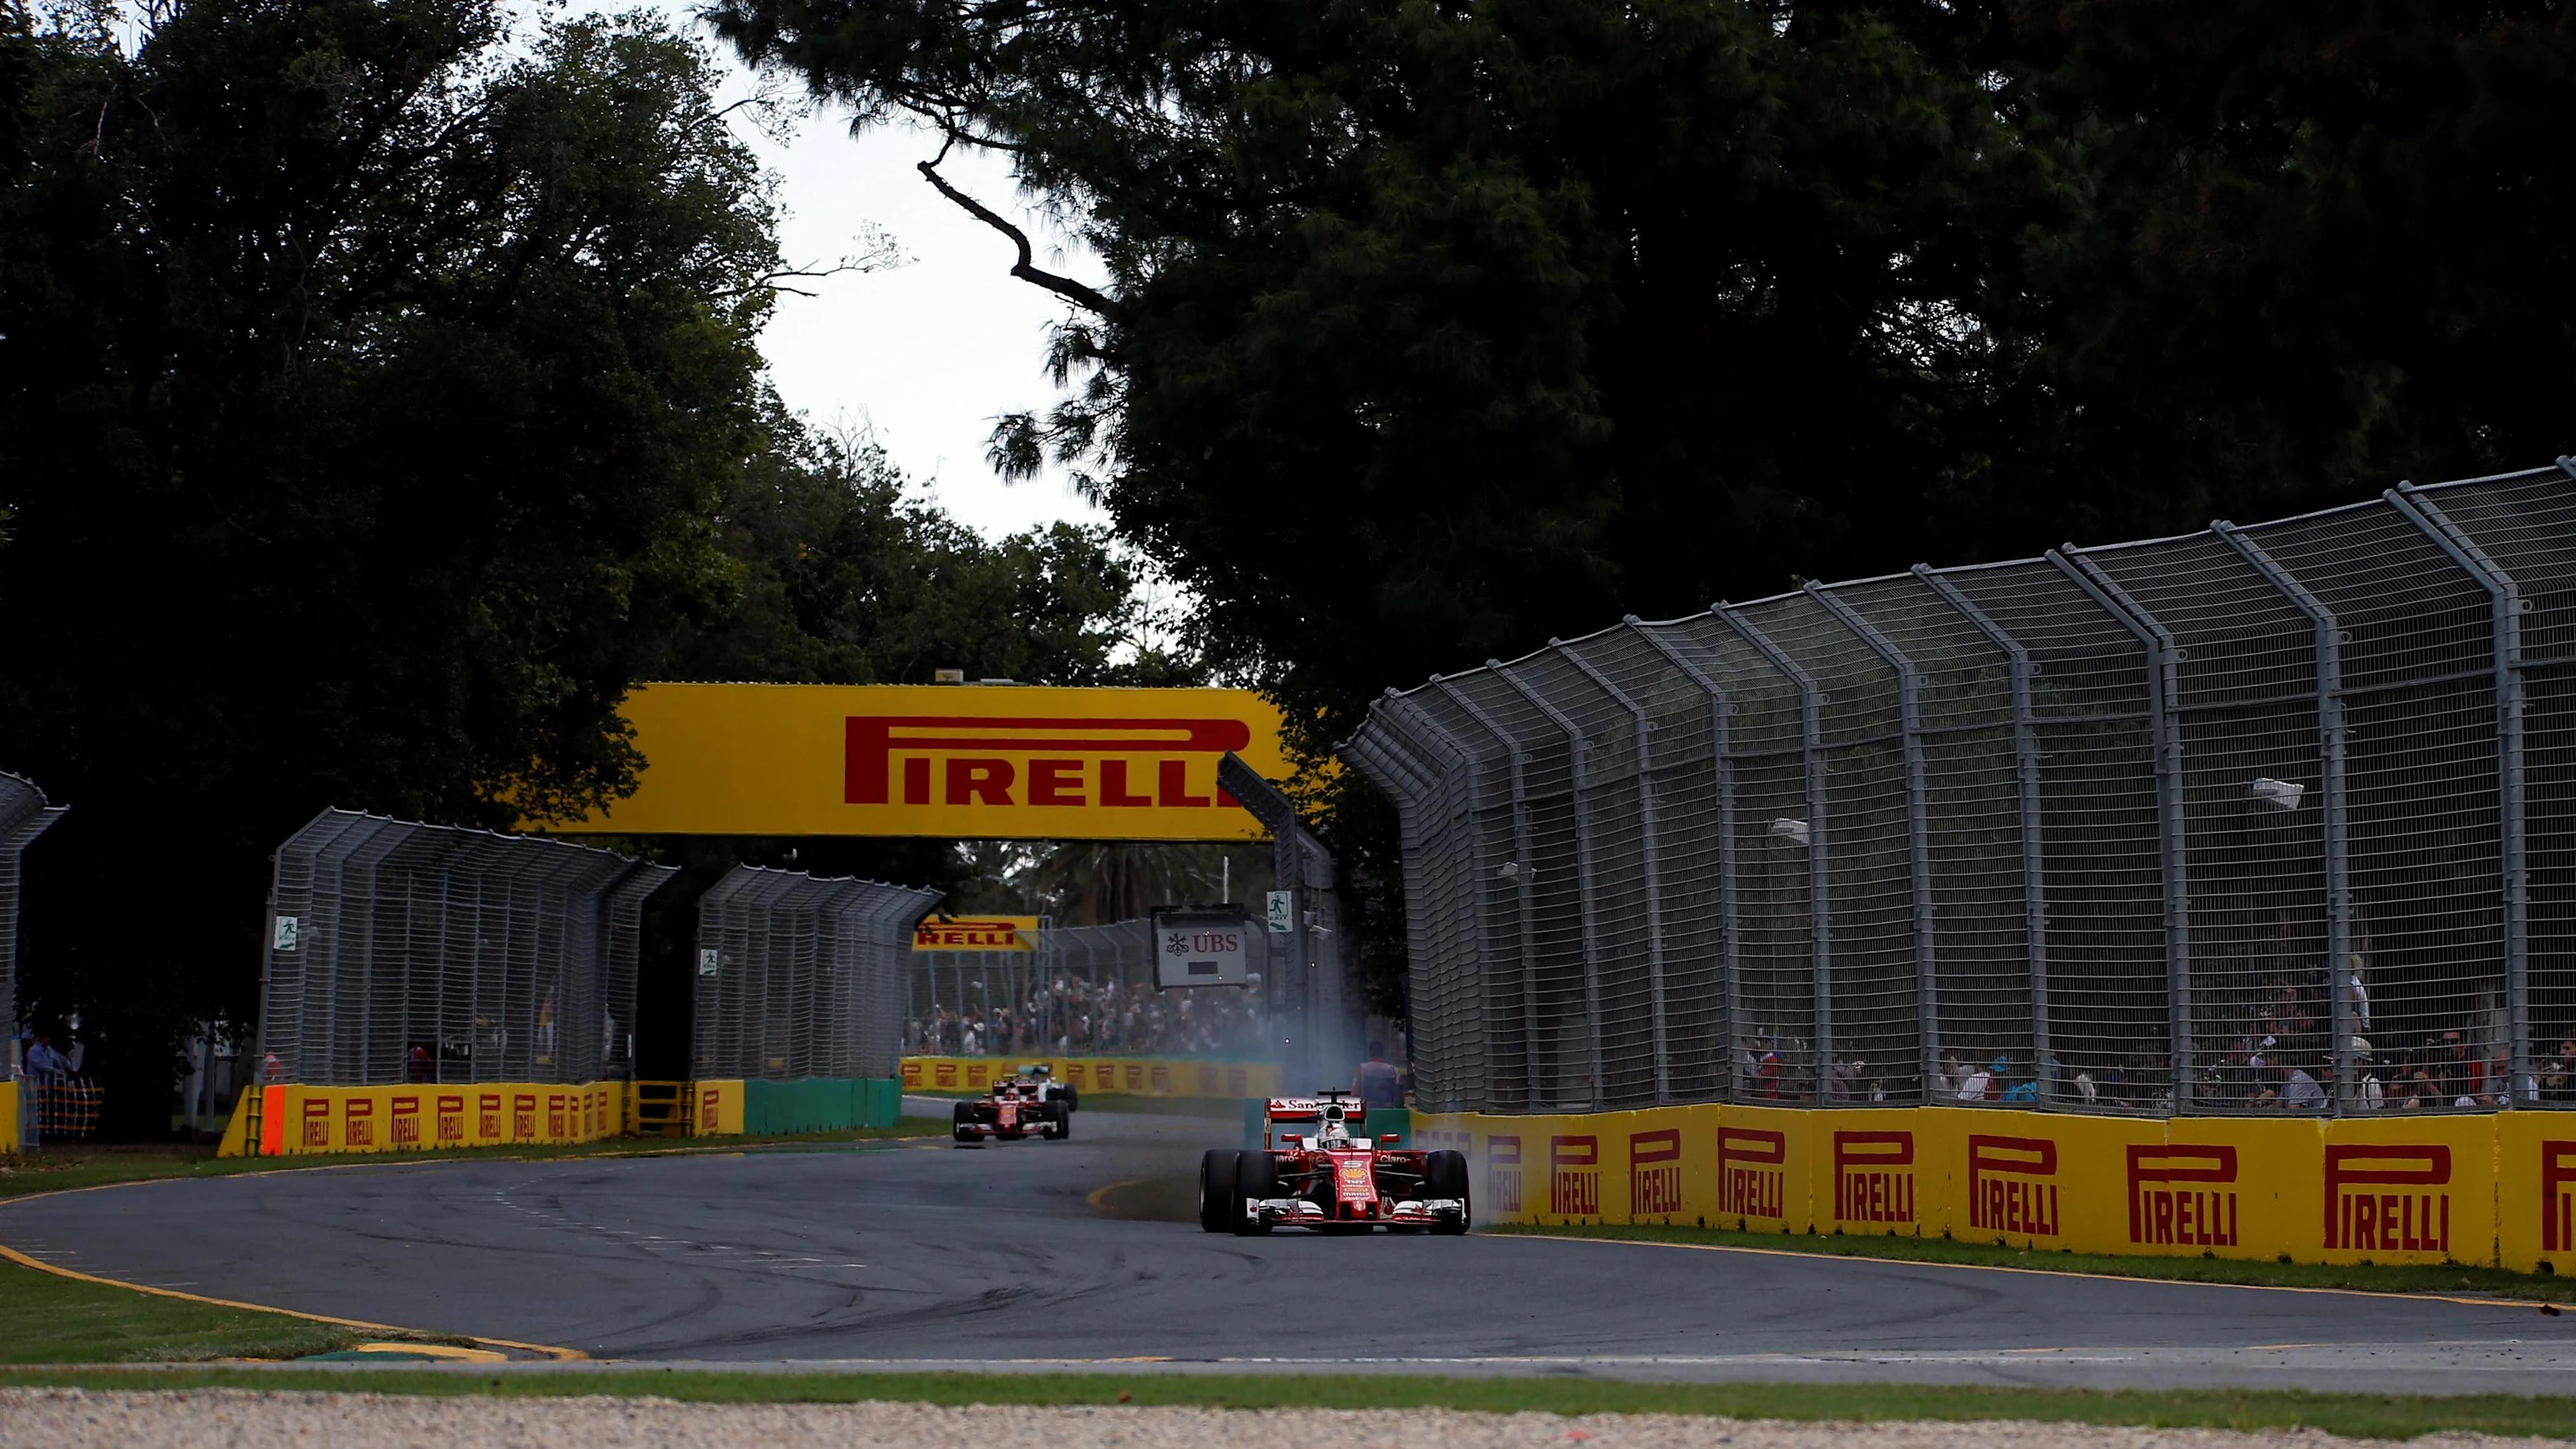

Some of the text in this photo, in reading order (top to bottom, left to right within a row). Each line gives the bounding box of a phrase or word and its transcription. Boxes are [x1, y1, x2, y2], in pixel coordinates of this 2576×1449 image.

[845, 716, 1250, 808] PIRELL
[1192, 934, 1238, 952] UBS
[1275, 1154, 1295, 1162] laro
[1380, 1154, 1407, 1163] Claro
[1487, 1135, 1521, 1212] PIRELLI
[1550, 1134, 1599, 1215] PIRELLI
[1629, 1128, 1681, 1216] PIRELLI
[1718, 1126, 1785, 1219] PIRELLI
[1834, 1130, 1914, 1223] PIRELLI
[1968, 1134, 2058, 1236] PIRELLI
[2126, 1143, 2238, 1247] PIRELLI
[2323, 1143, 2451, 1252] PIRELLI
